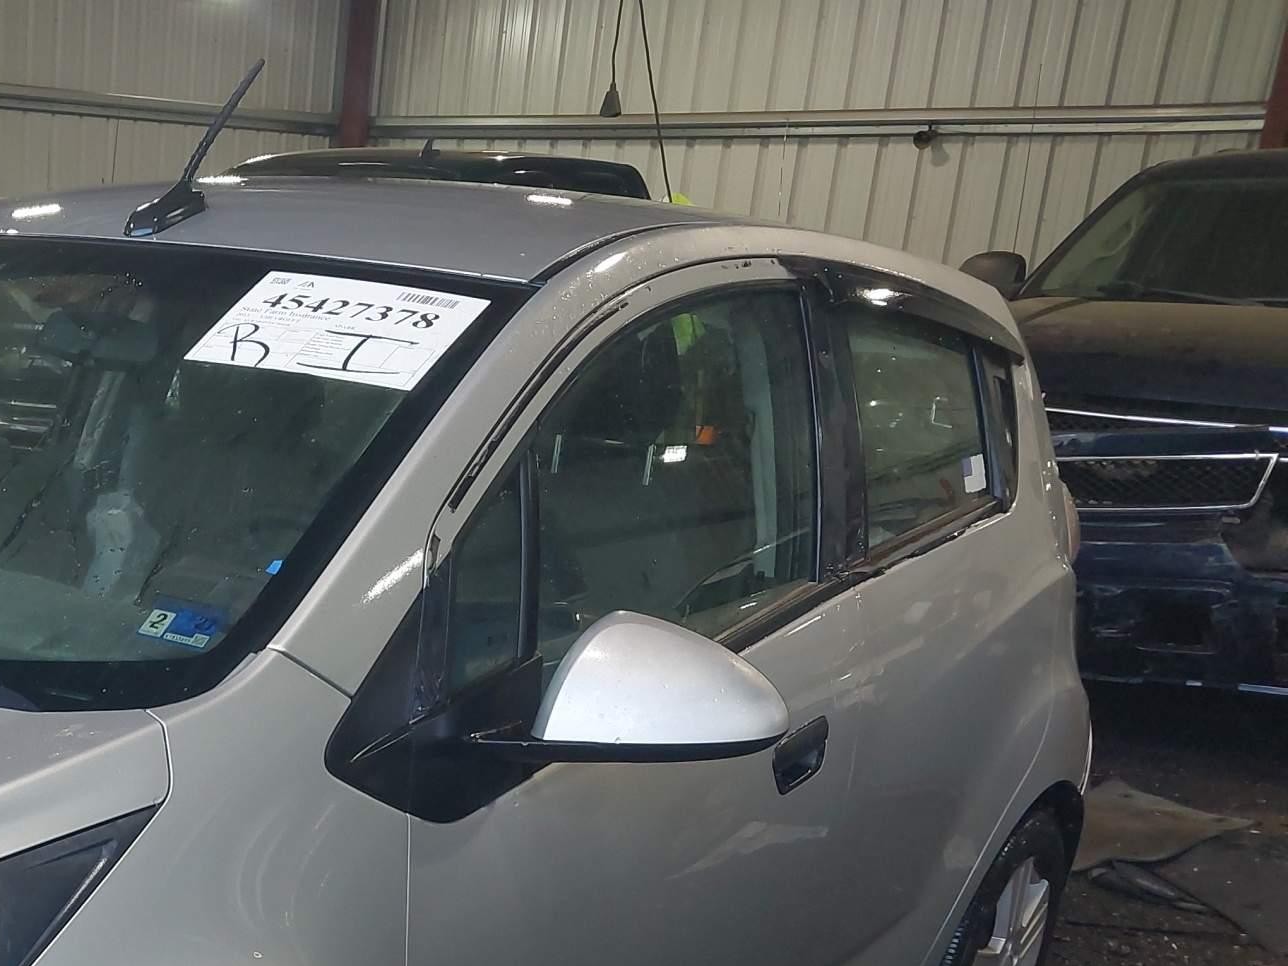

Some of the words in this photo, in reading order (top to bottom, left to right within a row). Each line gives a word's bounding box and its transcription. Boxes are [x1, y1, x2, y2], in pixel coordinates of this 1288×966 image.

[262, 293, 440, 330] 45427378
[264, 307, 288, 317] Farm
[289, 310, 332, 322] Insurance
[149, 613, 168, 630] 2
